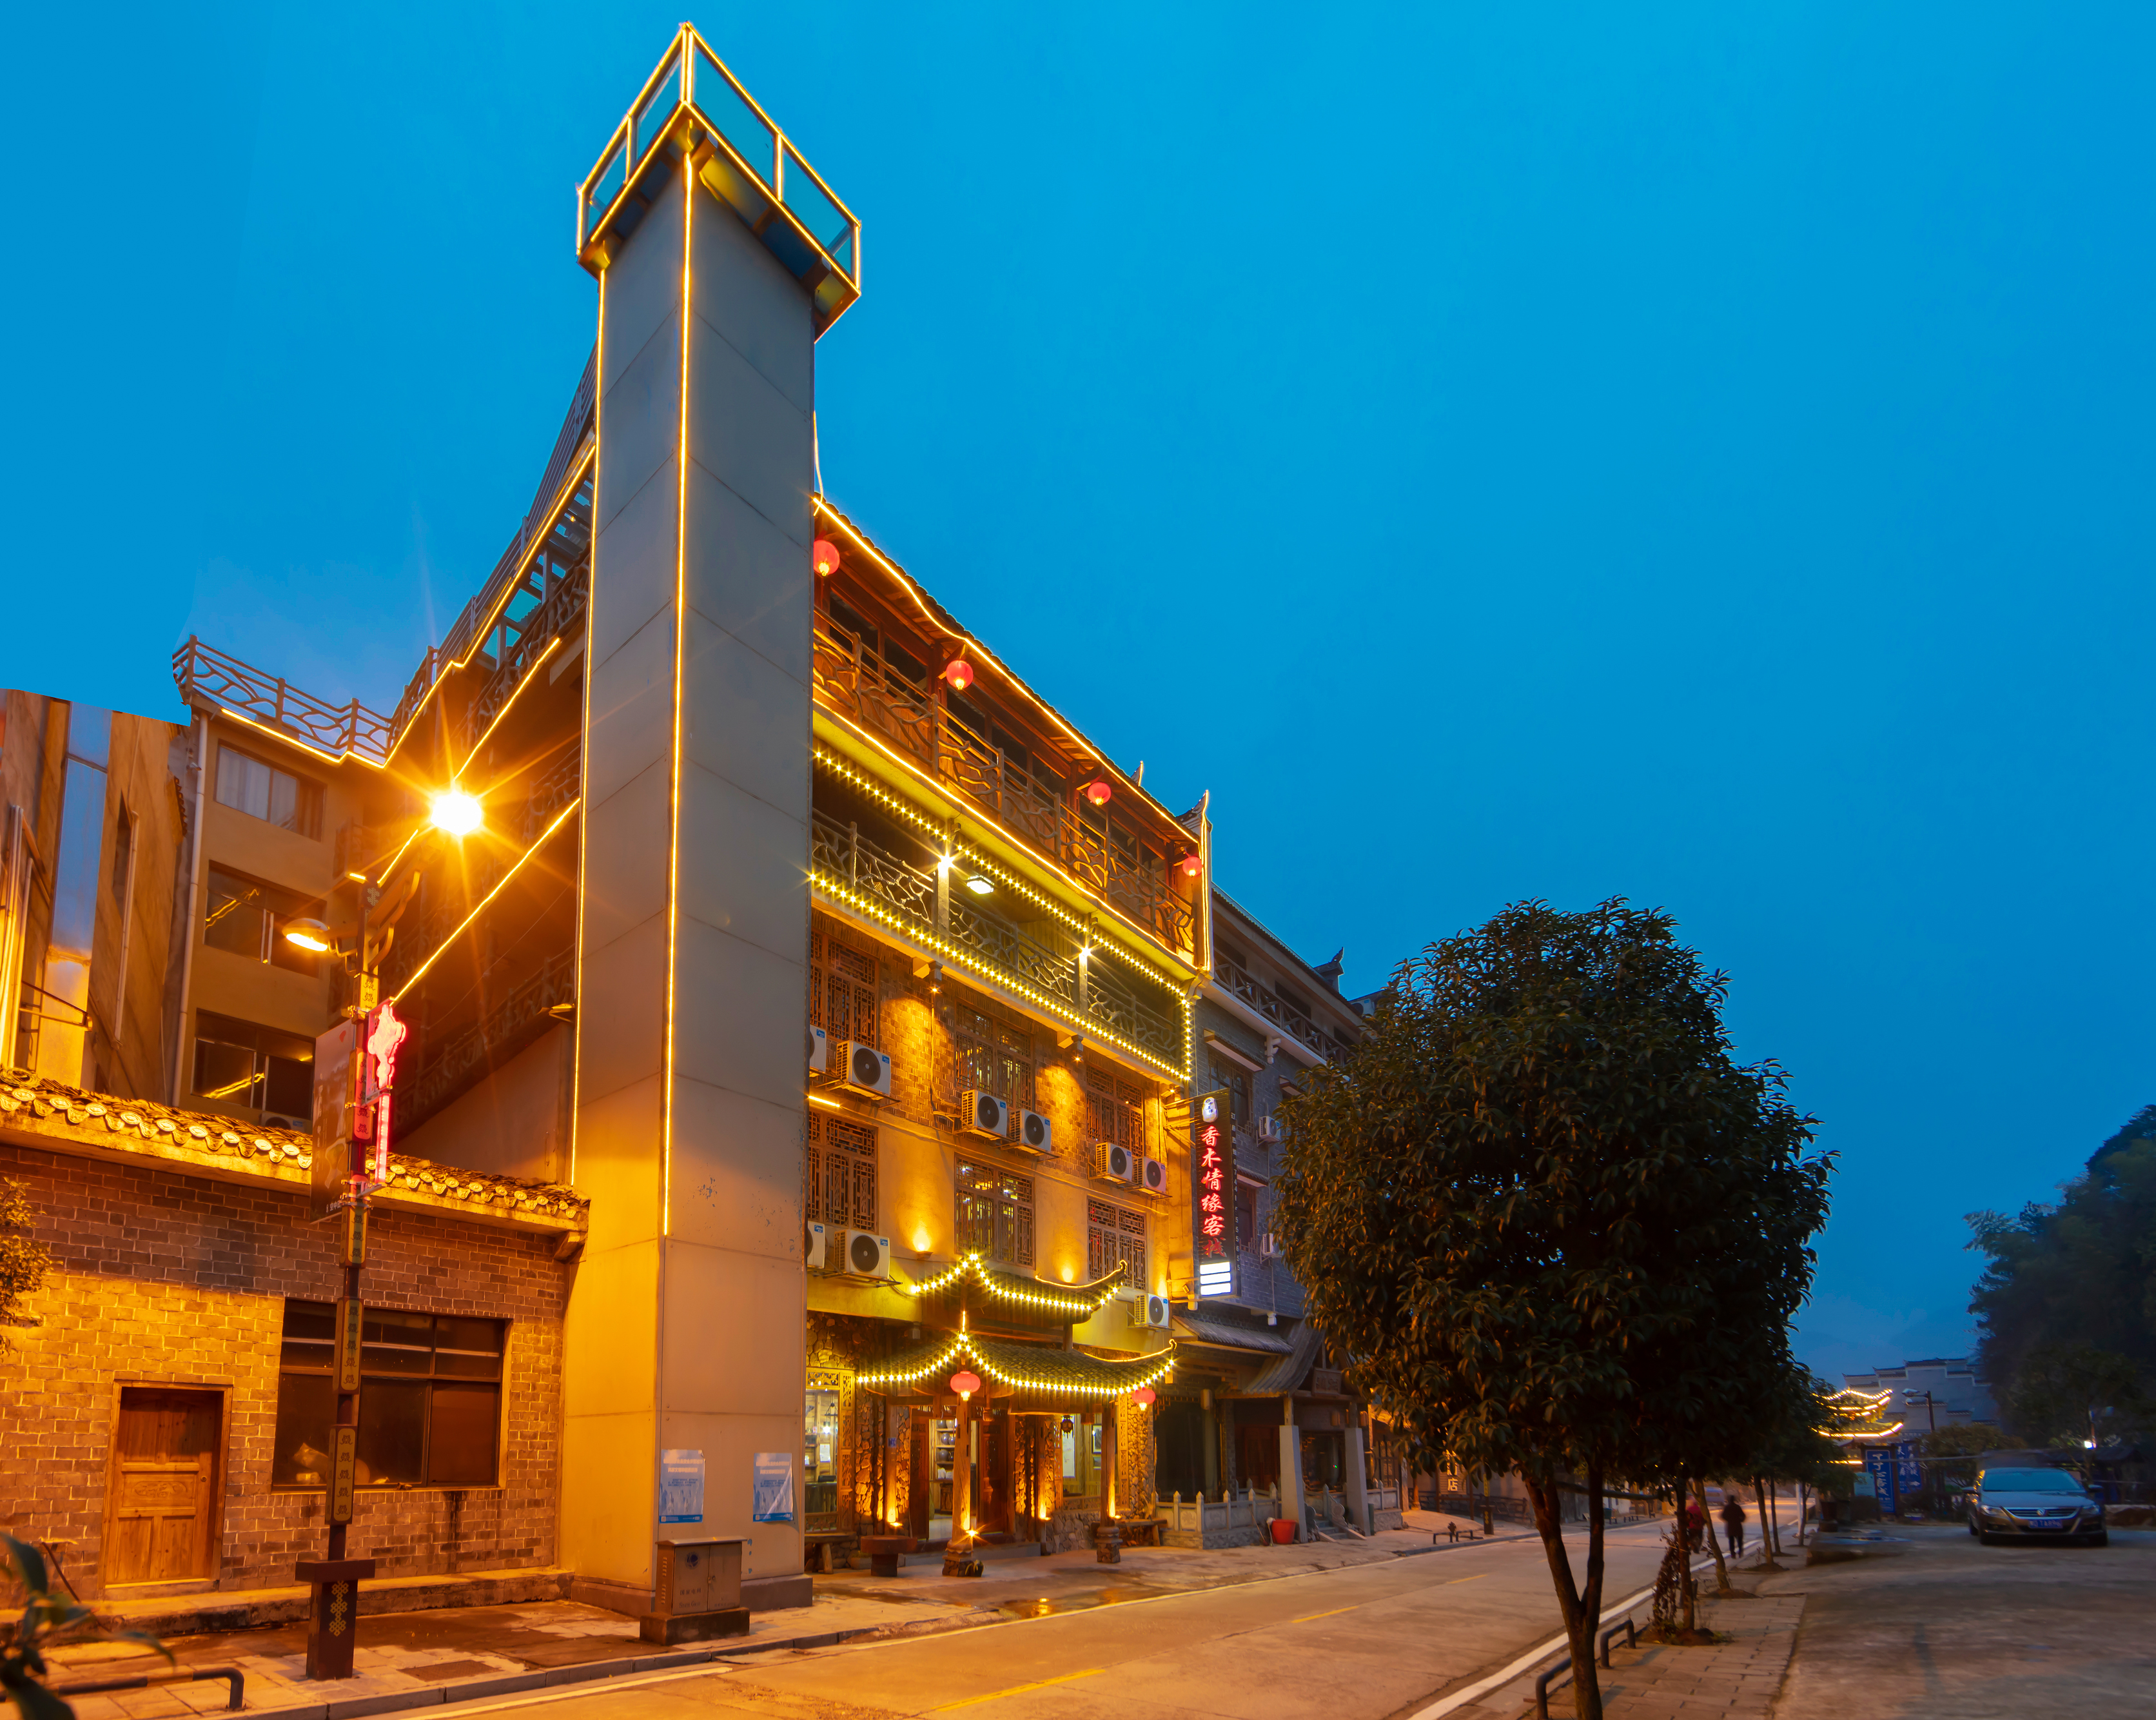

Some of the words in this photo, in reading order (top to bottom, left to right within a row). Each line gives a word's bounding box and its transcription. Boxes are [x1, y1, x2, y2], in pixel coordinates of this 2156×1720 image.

[1200, 1125, 1227, 1258] 香木情缘客栈
